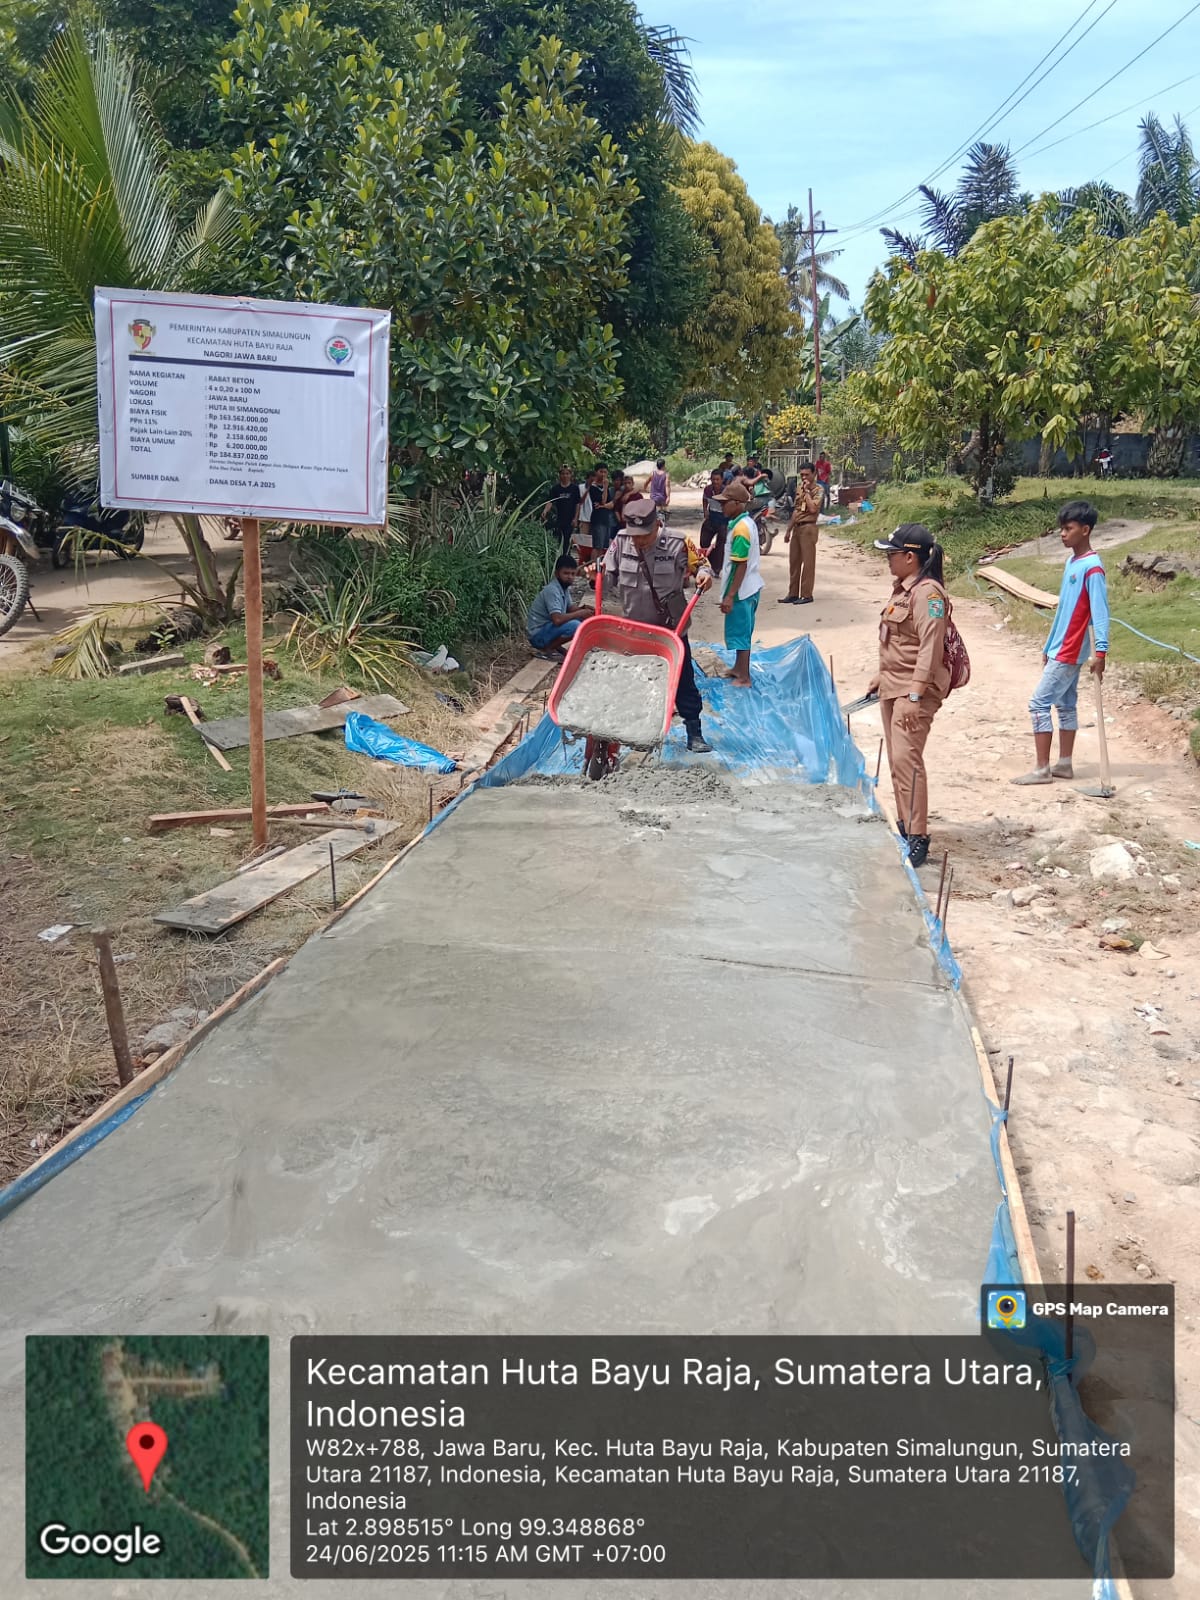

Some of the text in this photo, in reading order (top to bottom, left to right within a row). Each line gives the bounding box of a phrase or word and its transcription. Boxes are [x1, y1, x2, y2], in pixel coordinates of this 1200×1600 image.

[169, 323, 311, 340] PEMERINTAH KABUPATEN SIMALUNGUN
[187, 337, 293, 351] KECAMATAN HUTA BAYU RAJA
[203, 350, 277, 362] NAGORI JAWA BARU
[152, 371, 185, 380] KEGIATAN
[129, 379, 158, 387] VOLUME
